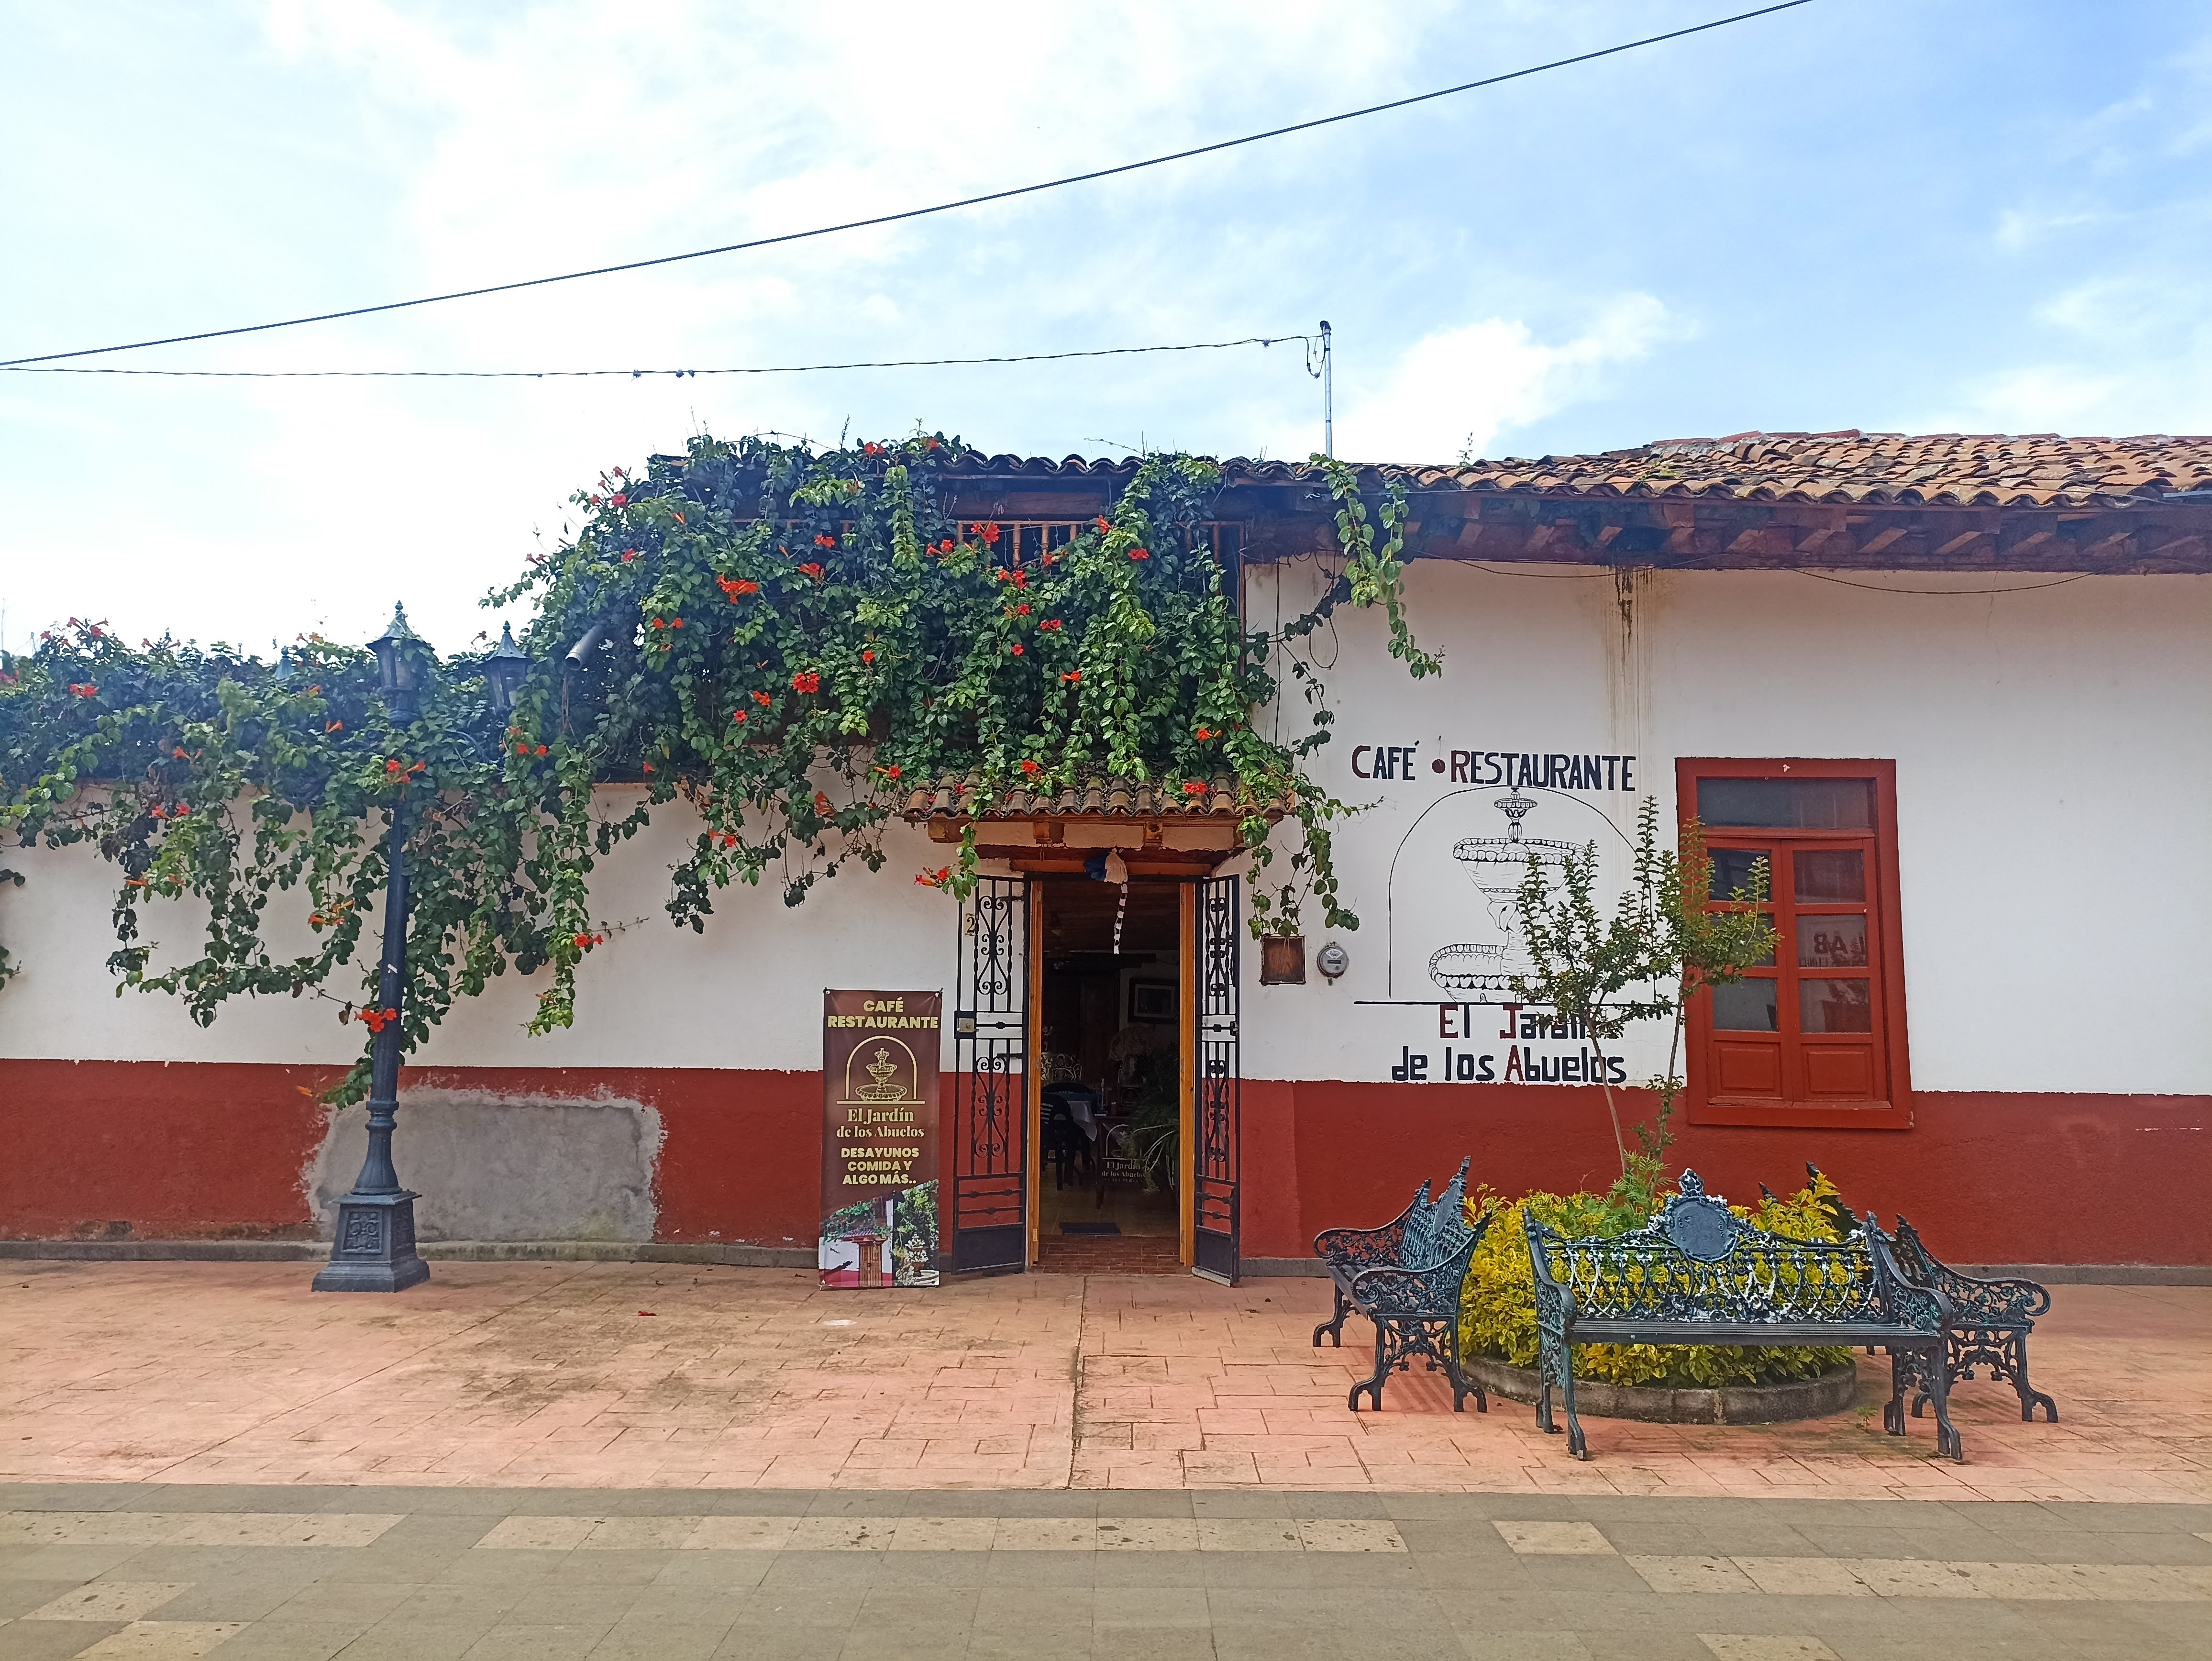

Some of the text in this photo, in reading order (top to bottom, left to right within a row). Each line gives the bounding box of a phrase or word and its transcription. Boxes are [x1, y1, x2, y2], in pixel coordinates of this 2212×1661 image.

[1351, 740, 1636, 791] CAFÉ RESTAURANTE
[863, 997, 904, 1012] CAFÉ
[828, 1016, 938, 1029] RESTAURANTE
[1439, 1005, 1470, 1039] El
[1392, 1045, 1626, 1084] de los Abuelos
[848, 1107, 914, 1124] El Jardín
[836, 1126, 924, 1138] de los Abuelos
[841, 1148, 919, 1158] DESAYUNOS
[848, 1161, 912, 1171] COMIDA Y
[842, 1171, 916, 1185] ALGO MÁS..
